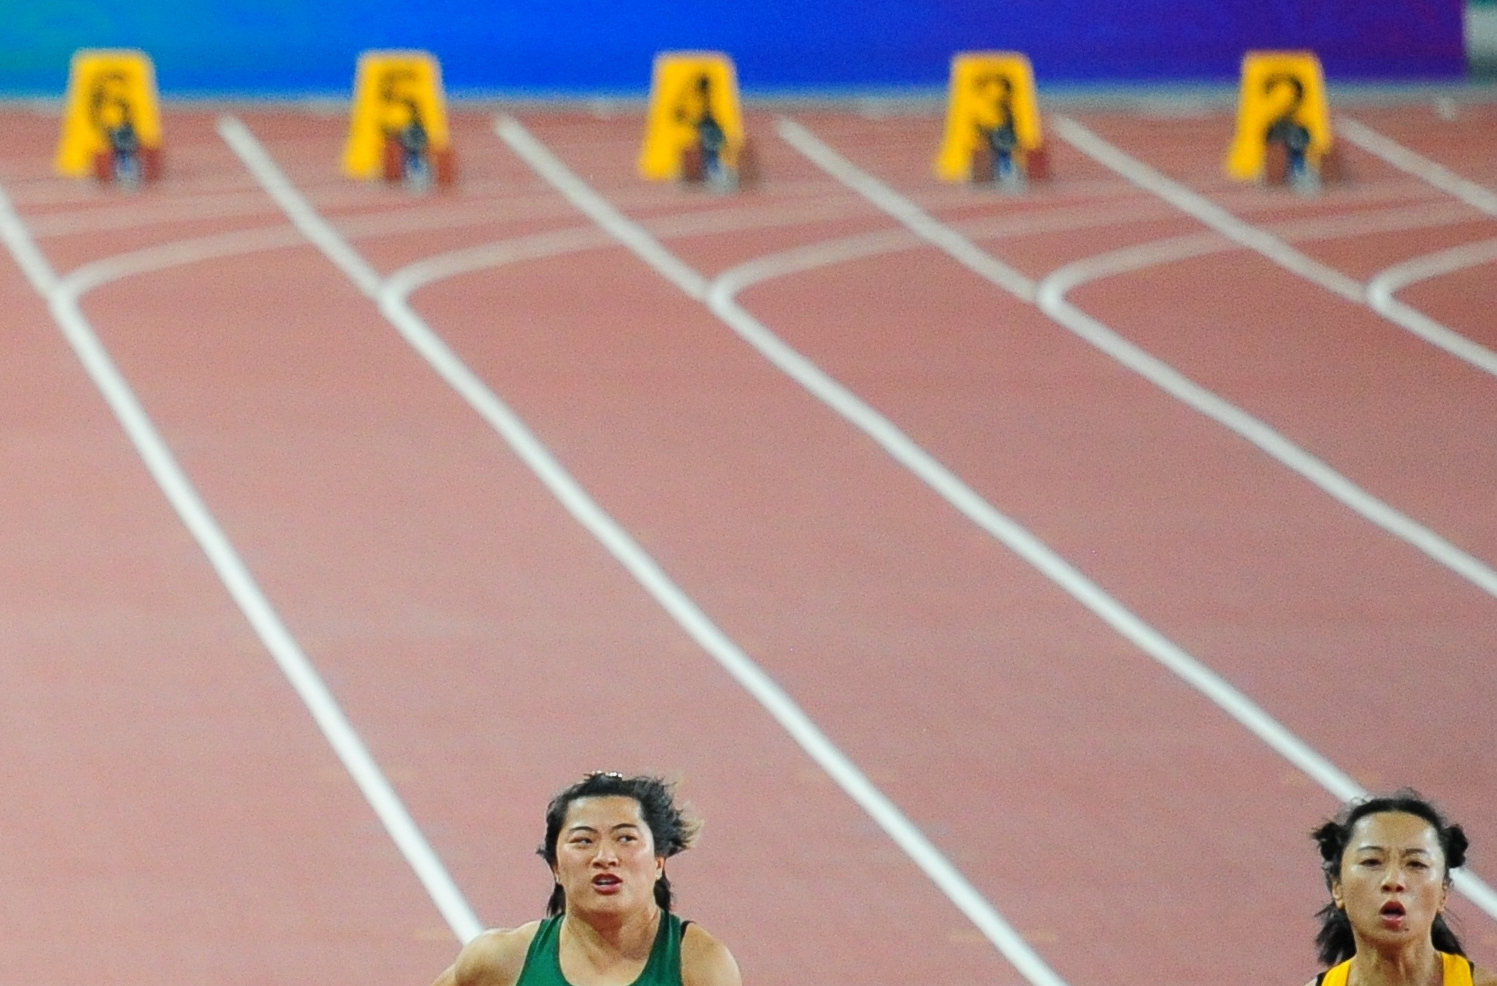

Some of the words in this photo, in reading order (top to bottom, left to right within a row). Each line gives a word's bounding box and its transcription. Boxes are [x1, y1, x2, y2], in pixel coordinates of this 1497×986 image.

[91, 69, 131, 131] 6
[377, 68, 422, 131] 5
[972, 73, 1015, 134] 3
[1262, 73, 1305, 139] 2
